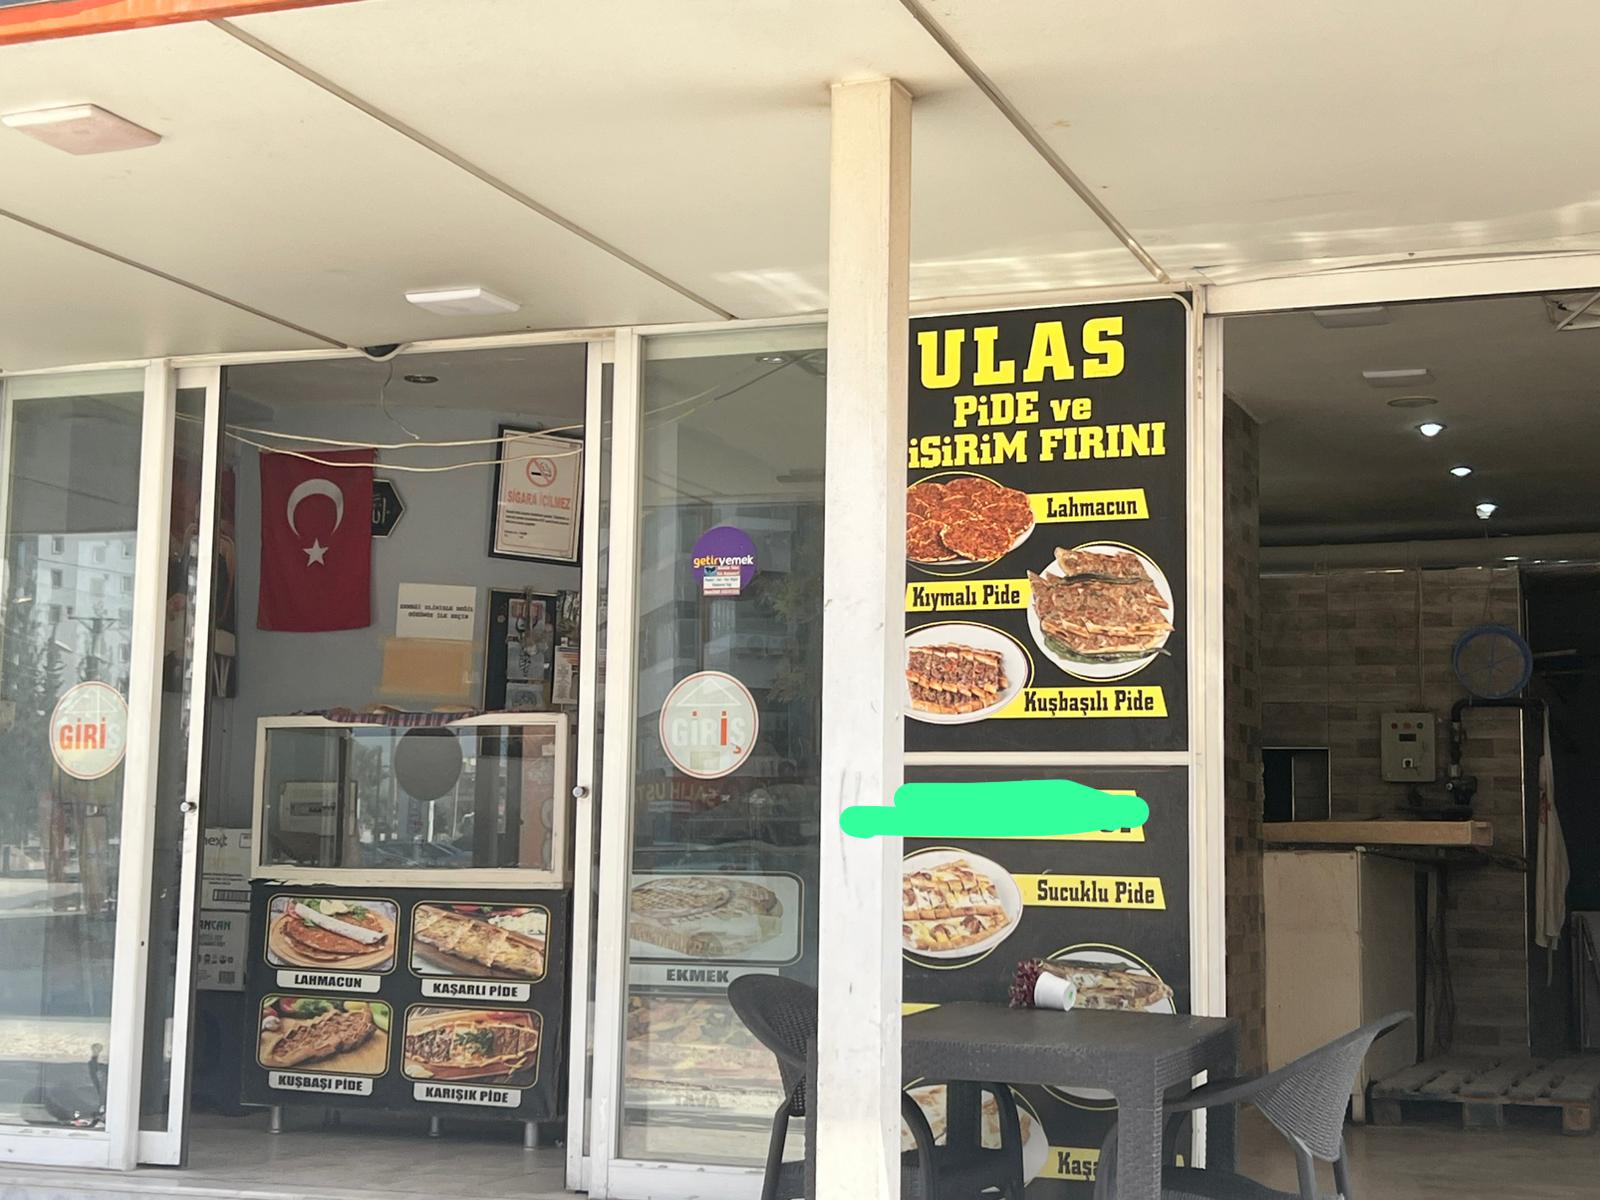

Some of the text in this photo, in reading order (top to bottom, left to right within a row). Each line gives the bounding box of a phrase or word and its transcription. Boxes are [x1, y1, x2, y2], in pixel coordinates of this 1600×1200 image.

[917, 316, 1125, 389] ULAS
[1050, 397, 1092, 422] ve
[1039, 422, 1166, 461] FIRINI
[1046, 497, 1138, 518] Lahmacun
[912, 584, 1020, 611] Kıymalı Pide
[1024, 690, 1154, 716] Kuşbaşılı Pide
[1037, 879, 1155, 904] Sucuklu Pide
[294, 974, 362, 988] LAHMACUN
[666, 968, 729, 983] EKMEK
[432, 982, 518, 997] KAŞARLI PİDE
[278, 1074, 363, 1091] KUŞBAŞI PİDE
[425, 1086, 509, 1103] KARIŞIK PİDE
